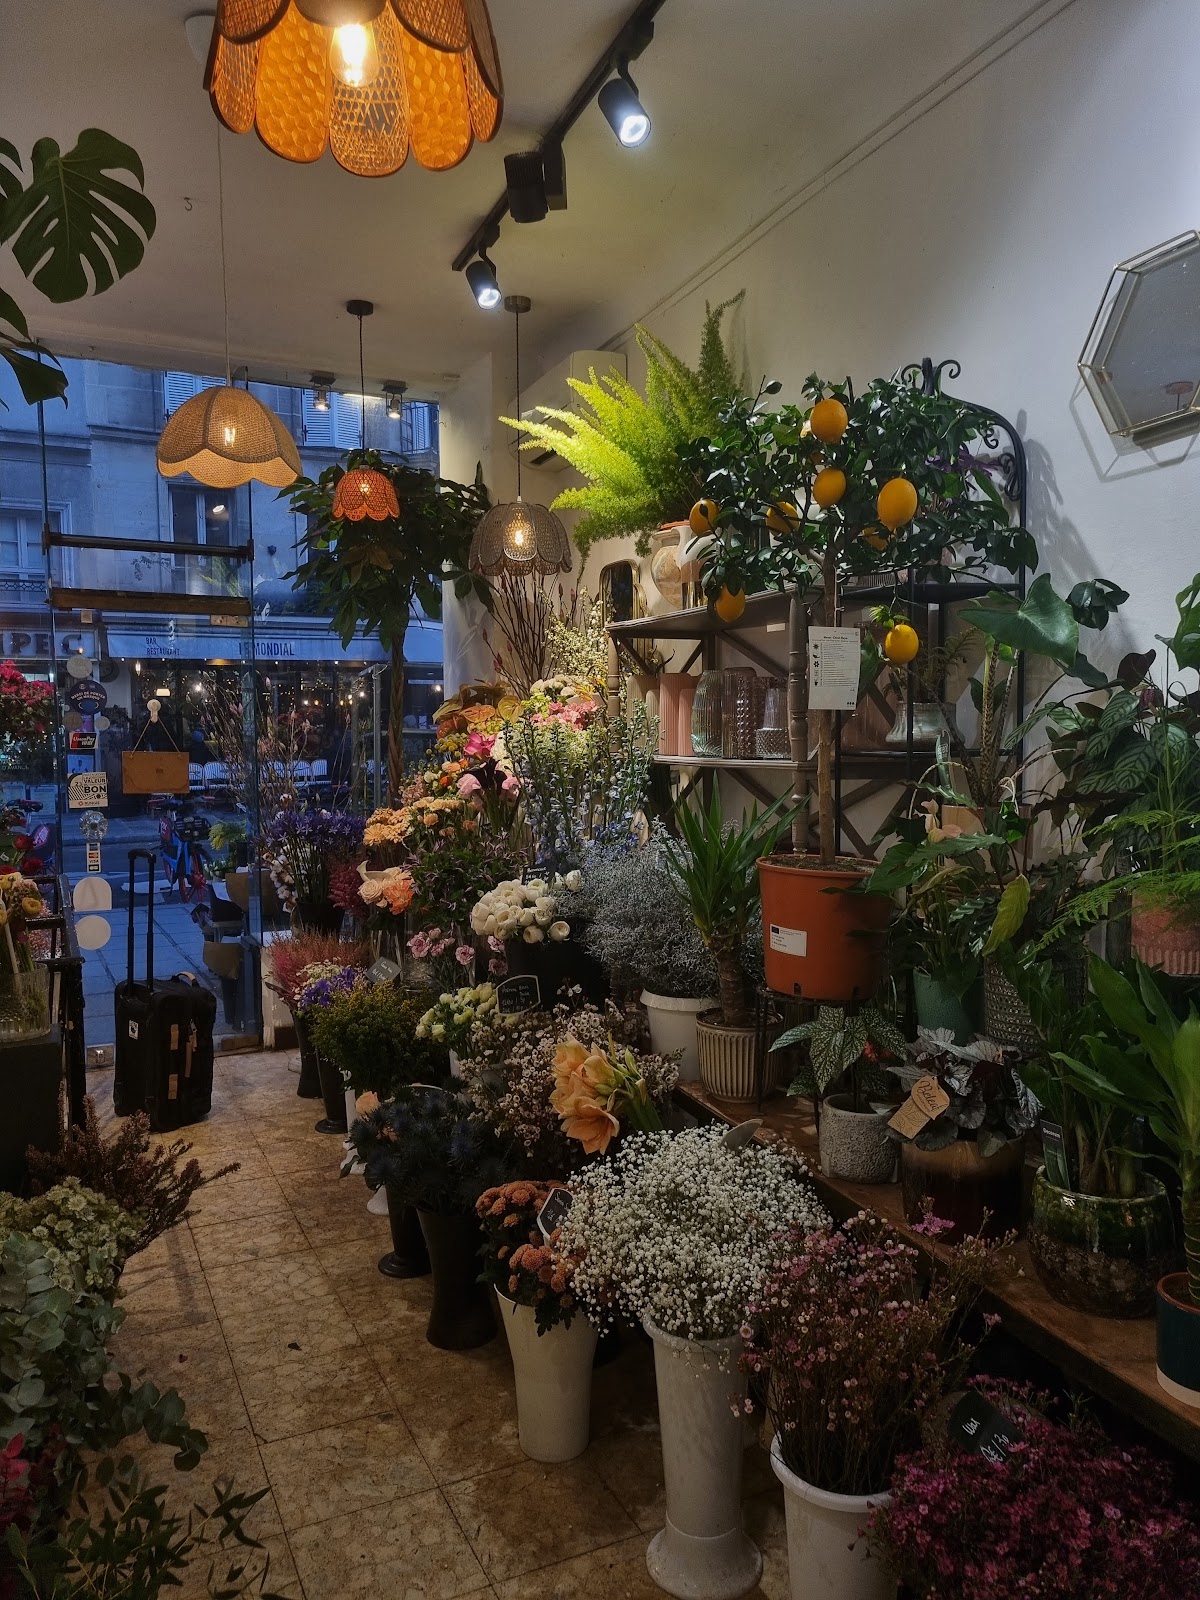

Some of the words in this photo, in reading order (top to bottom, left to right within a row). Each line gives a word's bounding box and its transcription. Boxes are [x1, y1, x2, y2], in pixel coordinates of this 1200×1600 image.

[145, 637, 157, 645] BAR
[146, 648, 180, 656] RESTAURANT
[254, 642, 295, 656] MONDIAL
